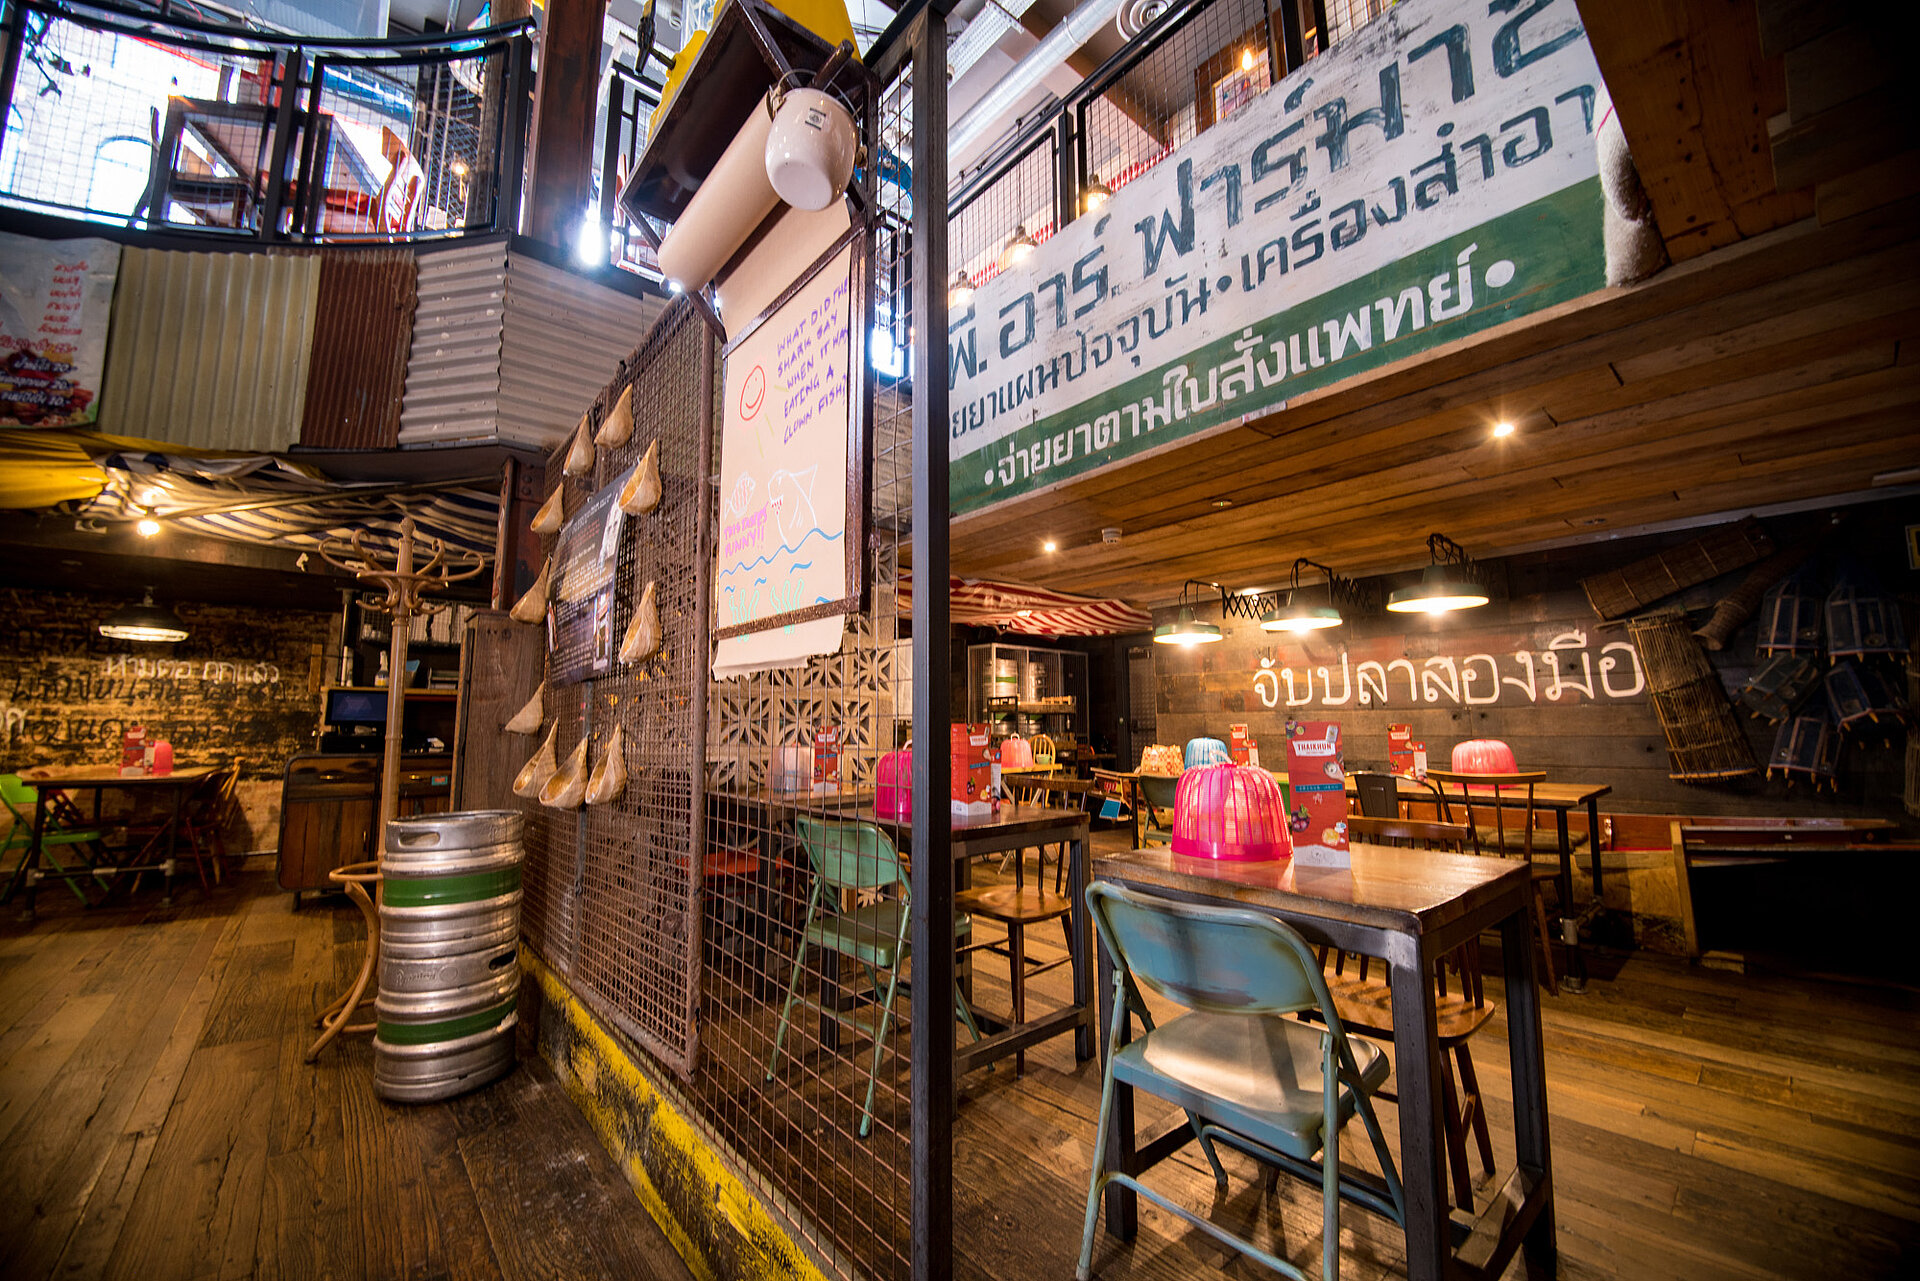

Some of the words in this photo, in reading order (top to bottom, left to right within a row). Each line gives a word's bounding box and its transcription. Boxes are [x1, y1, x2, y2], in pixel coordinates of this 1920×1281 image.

[777, 318, 806, 357] WHAT
[811, 297, 831, 326] DID
[833, 276, 848, 303] THE
[777, 336, 812, 378] SHARK
[816, 309, 838, 340] SAY
[784, 373, 820, 419] EATING
[826, 363, 834, 383] A
[787, 354, 814, 390] WHEN
[820, 341, 830, 360] IT
[783, 406, 813, 445] CLOWN
[1253, 630, 1645, 708] จับปลาสองมือ
